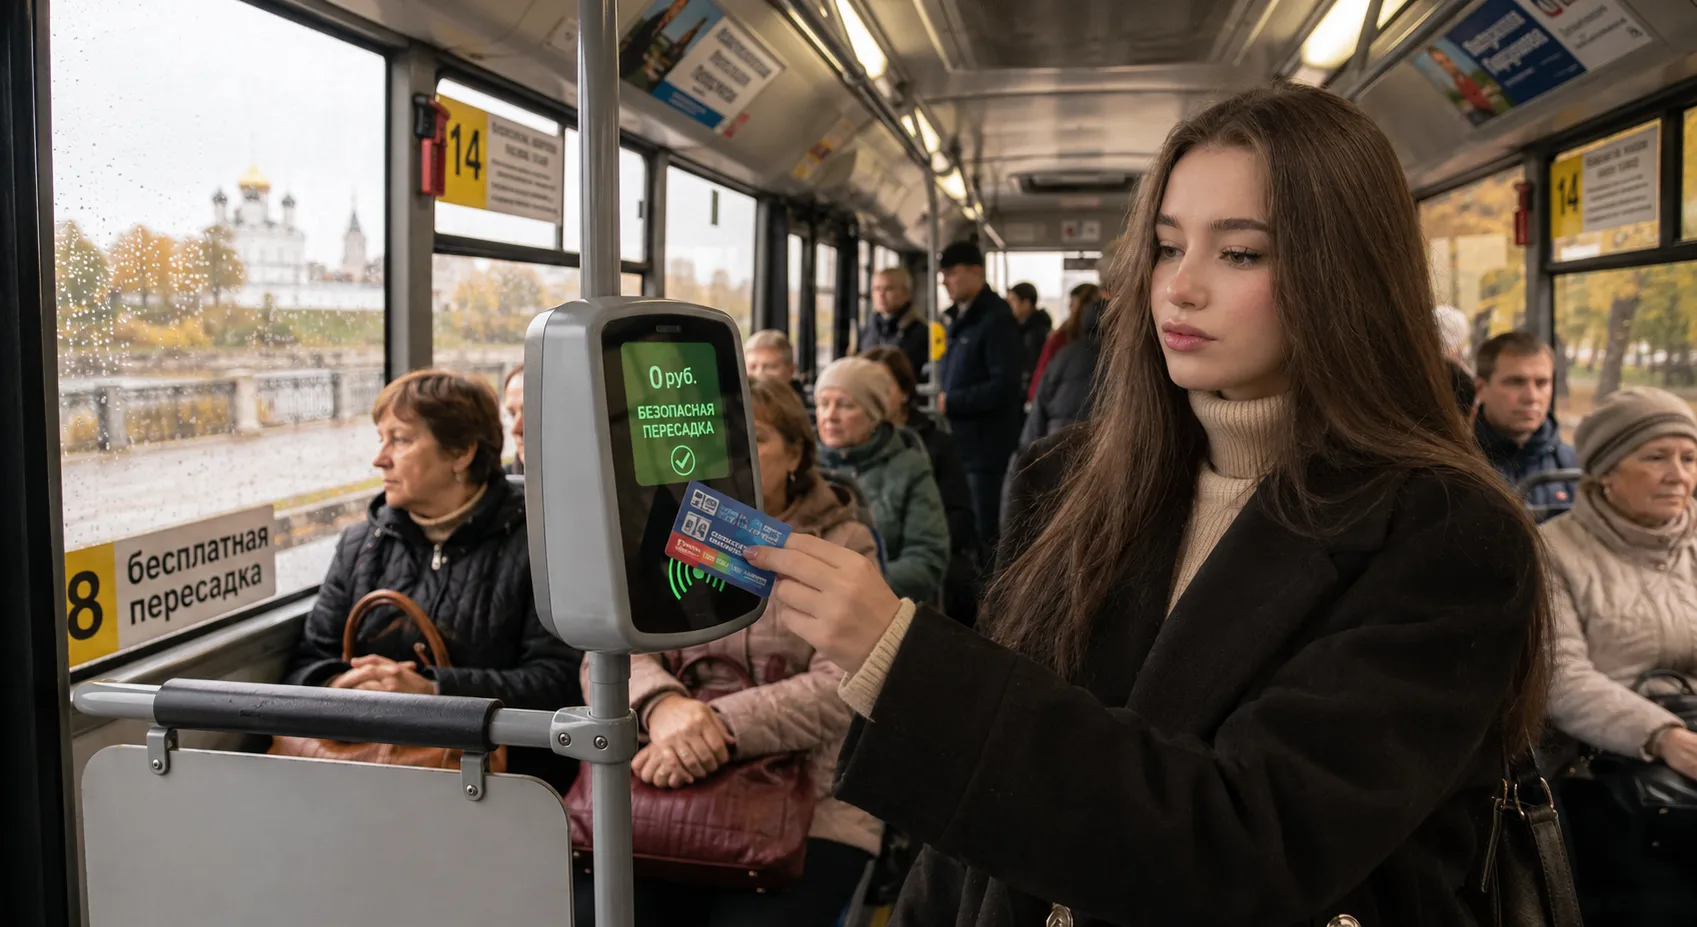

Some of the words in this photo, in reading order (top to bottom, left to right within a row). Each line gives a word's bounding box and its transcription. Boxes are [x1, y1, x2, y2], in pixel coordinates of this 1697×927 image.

[450, 123, 481, 180] 14
[1558, 171, 1578, 216] 14
[649, 365, 663, 389] 0
[665, 367, 697, 389] руб.
[637, 403, 715, 419] БЕЗОПАСНАЯ
[643, 421, 715, 438] ПЕРЕСАДКА
[127, 526, 269, 585] бесплатная
[67, 570, 103, 640] 8
[130, 563, 262, 625] пересадка
